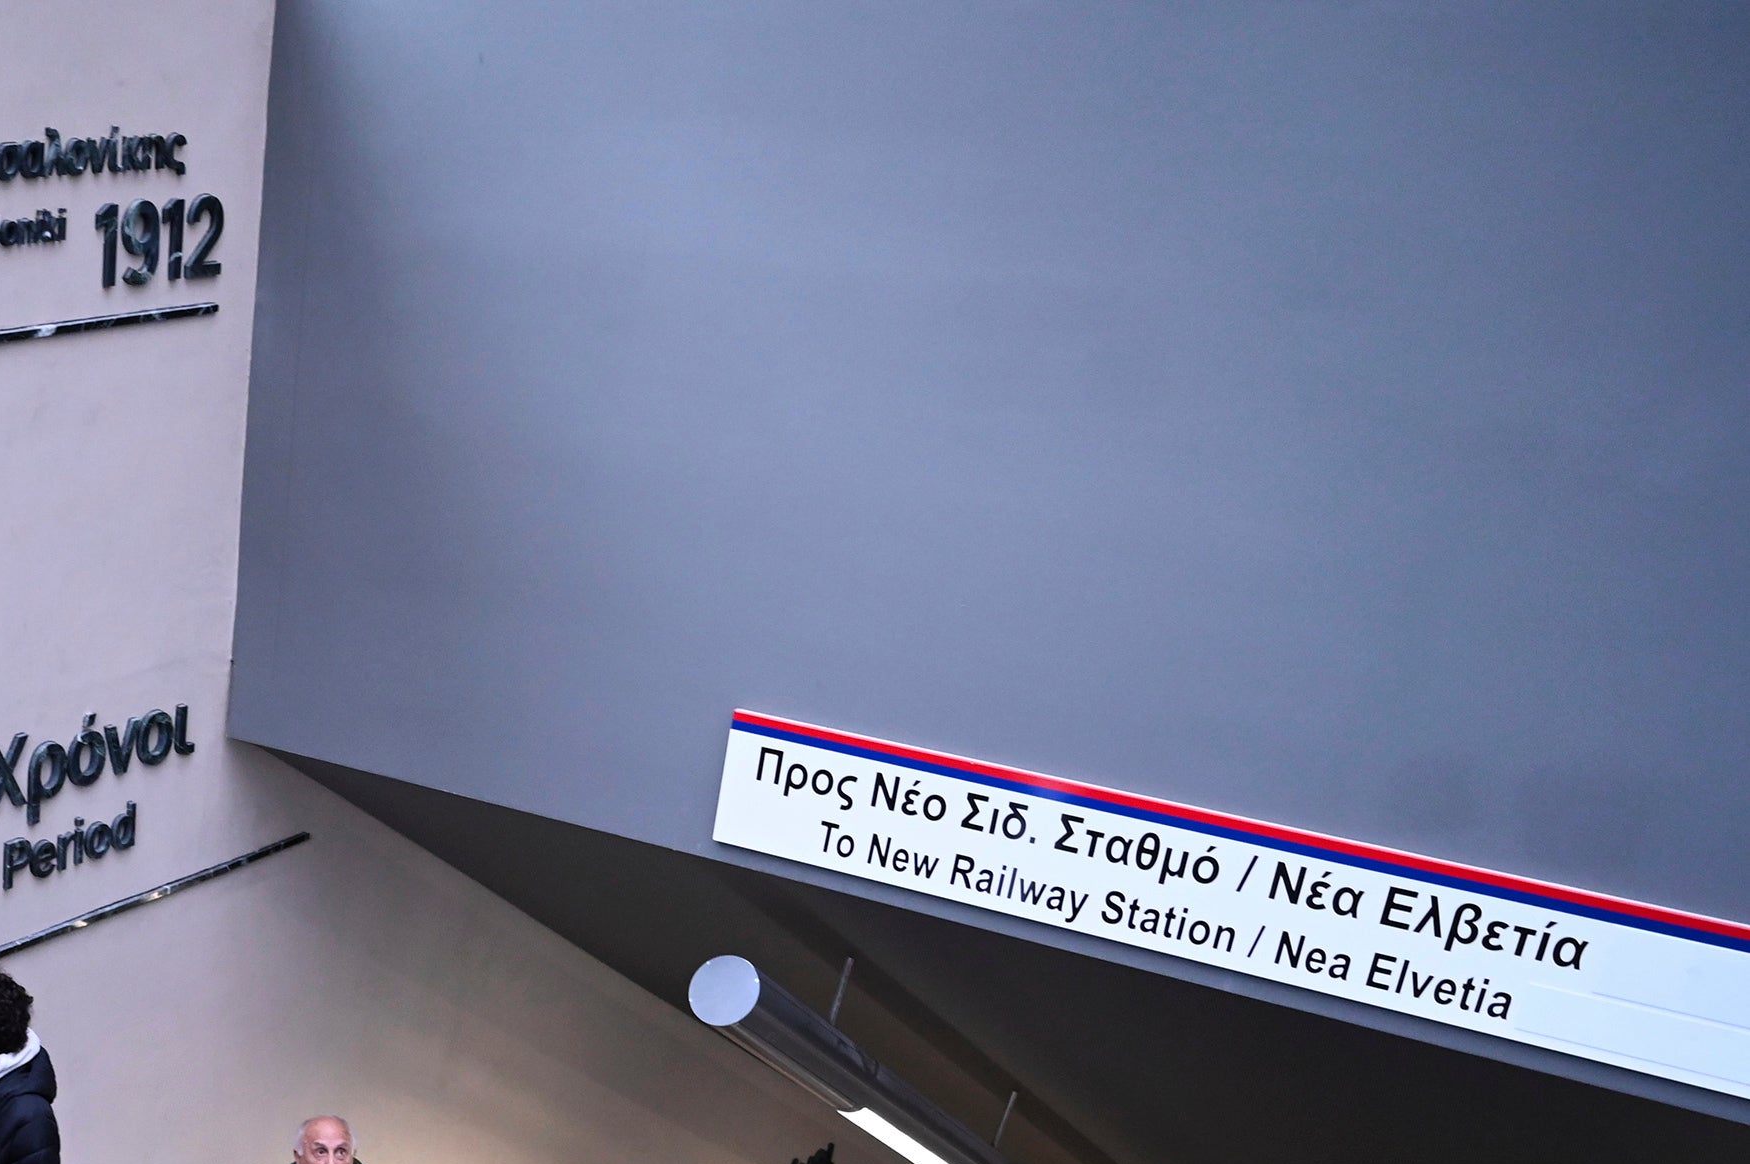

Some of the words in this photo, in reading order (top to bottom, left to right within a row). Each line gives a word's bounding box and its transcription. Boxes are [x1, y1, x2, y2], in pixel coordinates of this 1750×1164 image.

[95, 193, 225, 289] 1912
[3, 800, 137, 891] Period
[755, 746, 858, 810] Προς
[870, 772, 947, 822] Νέο
[961, 792, 1037, 844] Σιδ.
[1054, 813, 1220, 886] Σταθμό
[1236, 854, 1259, 892] /
[1268, 861, 1365, 919] Νέα
[1380, 887, 1590, 972] Ελβετία
[821, 821, 855, 858] To
[867, 833, 940, 880] New
[949, 854, 1089, 923] Railway
[1101, 890, 1236, 953] Station
[1247, 926, 1266, 958] /
[1274, 930, 1352, 982] Nea
[1366, 952, 1514, 1021] Elvetia
